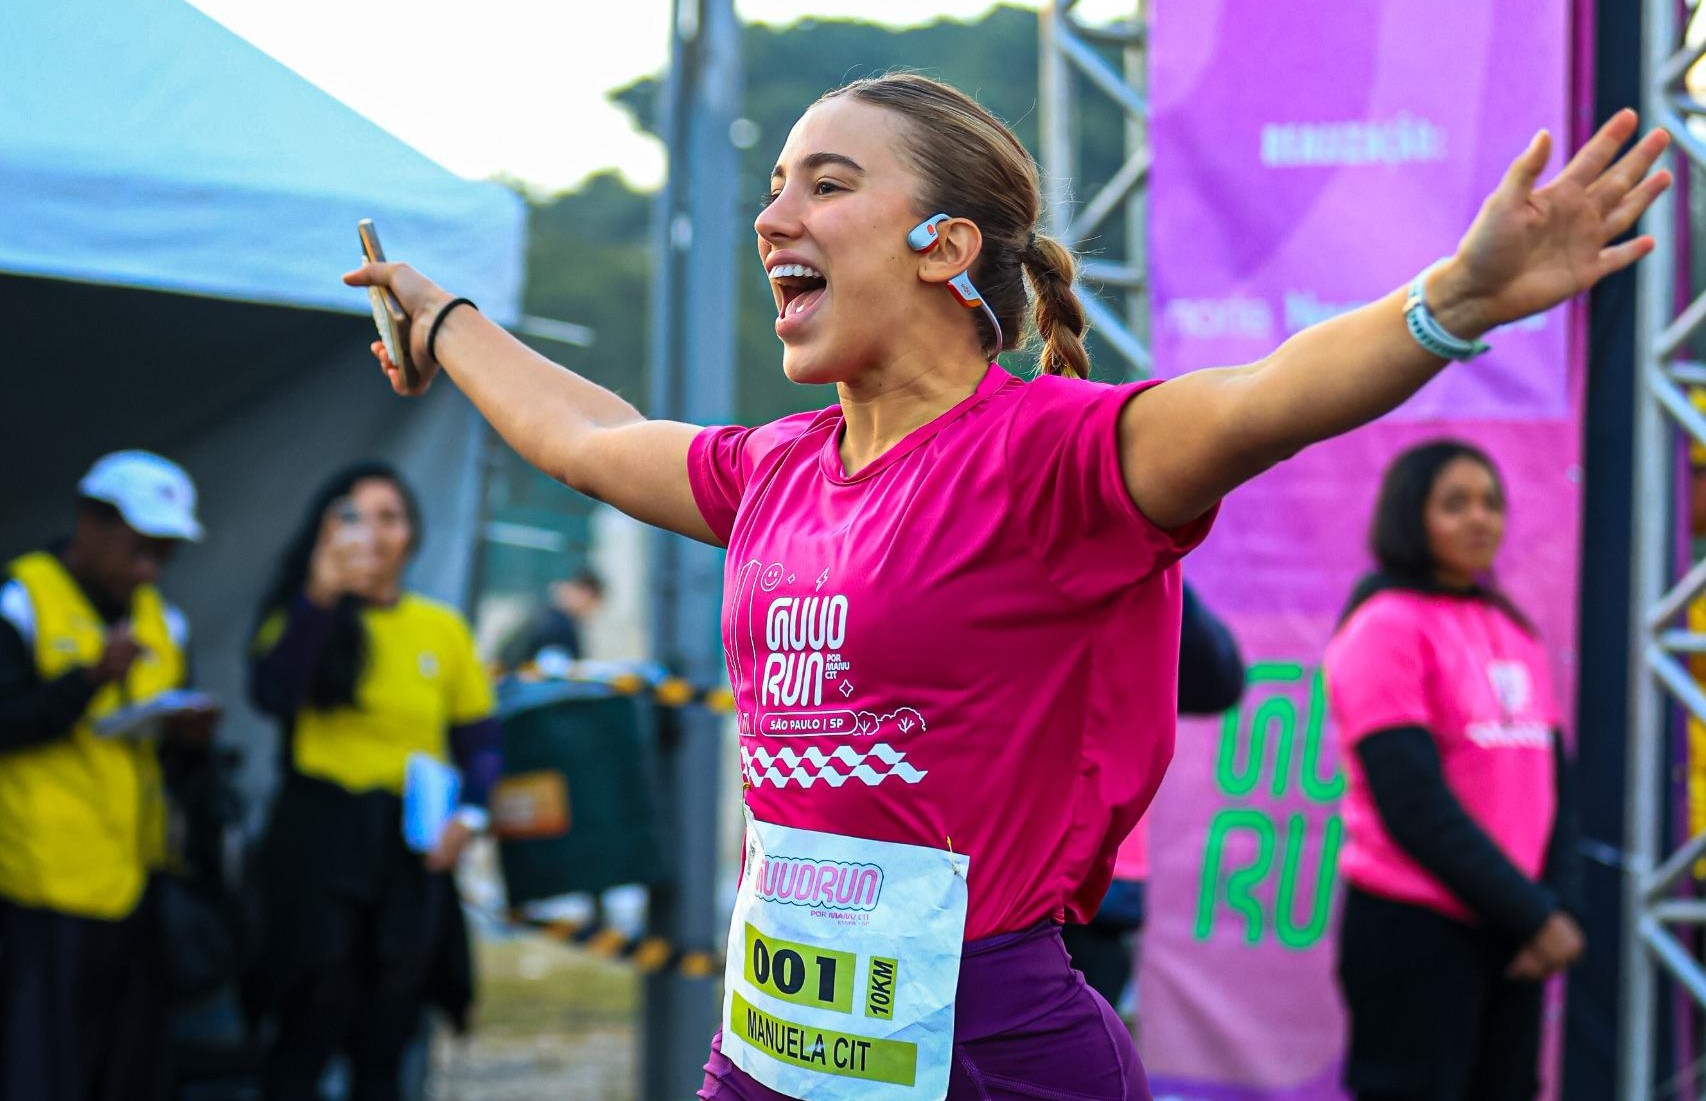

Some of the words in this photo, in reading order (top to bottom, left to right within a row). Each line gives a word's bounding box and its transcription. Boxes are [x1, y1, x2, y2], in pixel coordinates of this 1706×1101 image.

[766, 595, 848, 651] GUUD
[826, 662, 850, 670] MANU
[827, 654, 841, 662] POR
[762, 652, 823, 707] RUN
[825, 671, 837, 679] CIT
[770, 718, 788, 730] SÃO
[790, 719, 820, 730] PAULO
[830, 718, 843, 728] SP
[811, 910, 826, 918] POR
[753, 939, 836, 1002] 001
[869, 960, 894, 1015] 10KM
[747, 1007, 826, 1066] MANUELA
[833, 1037, 871, 1072] CIT
